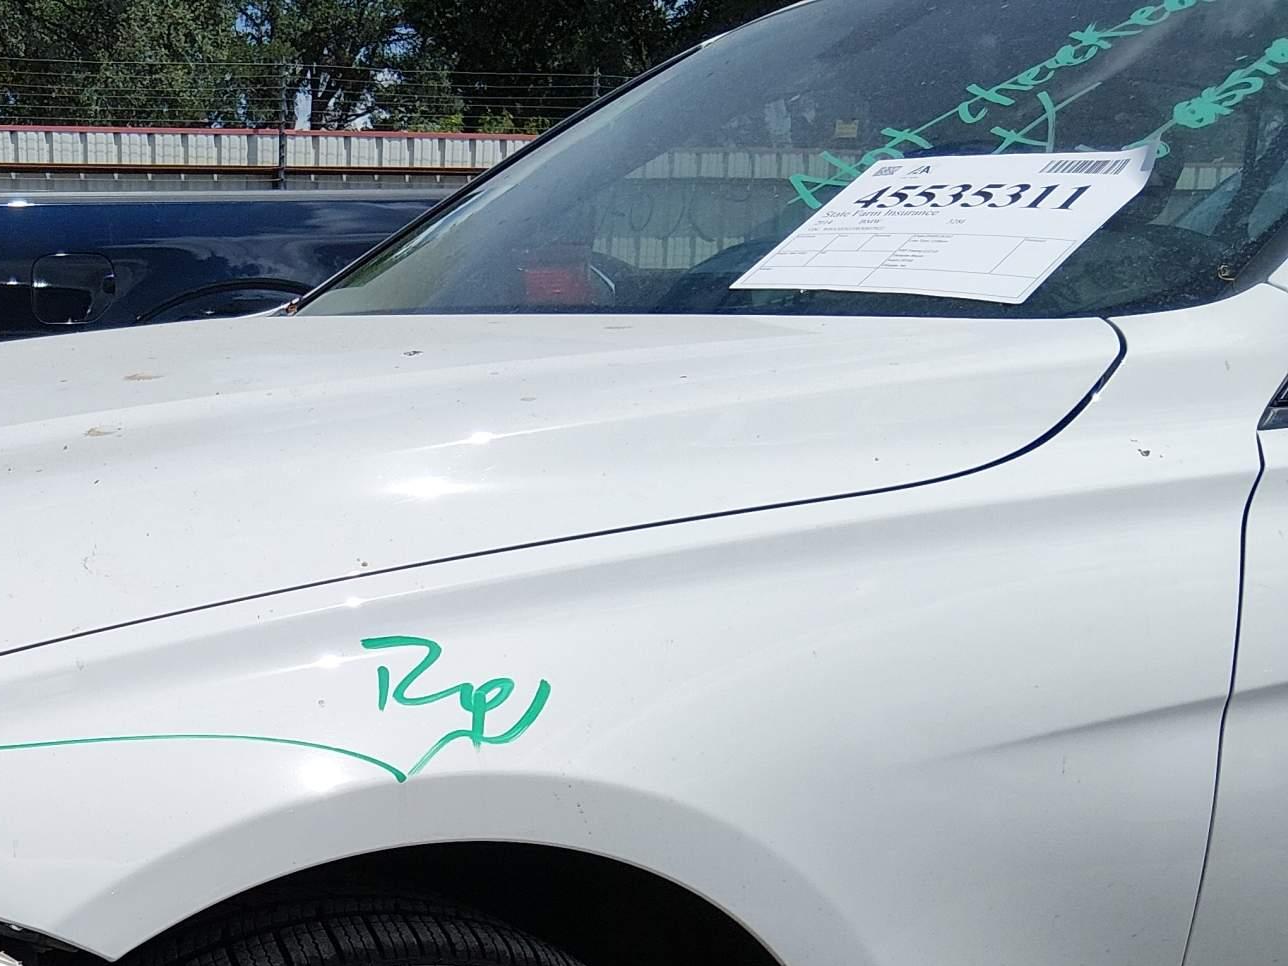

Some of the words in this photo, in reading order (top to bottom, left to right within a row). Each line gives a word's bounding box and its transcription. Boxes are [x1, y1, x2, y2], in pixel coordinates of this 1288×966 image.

[853, 183, 1092, 211] 45535311
[822, 210, 851, 218] State
[852, 209, 882, 218] Farm
[883, 208, 940, 217] Insurance
